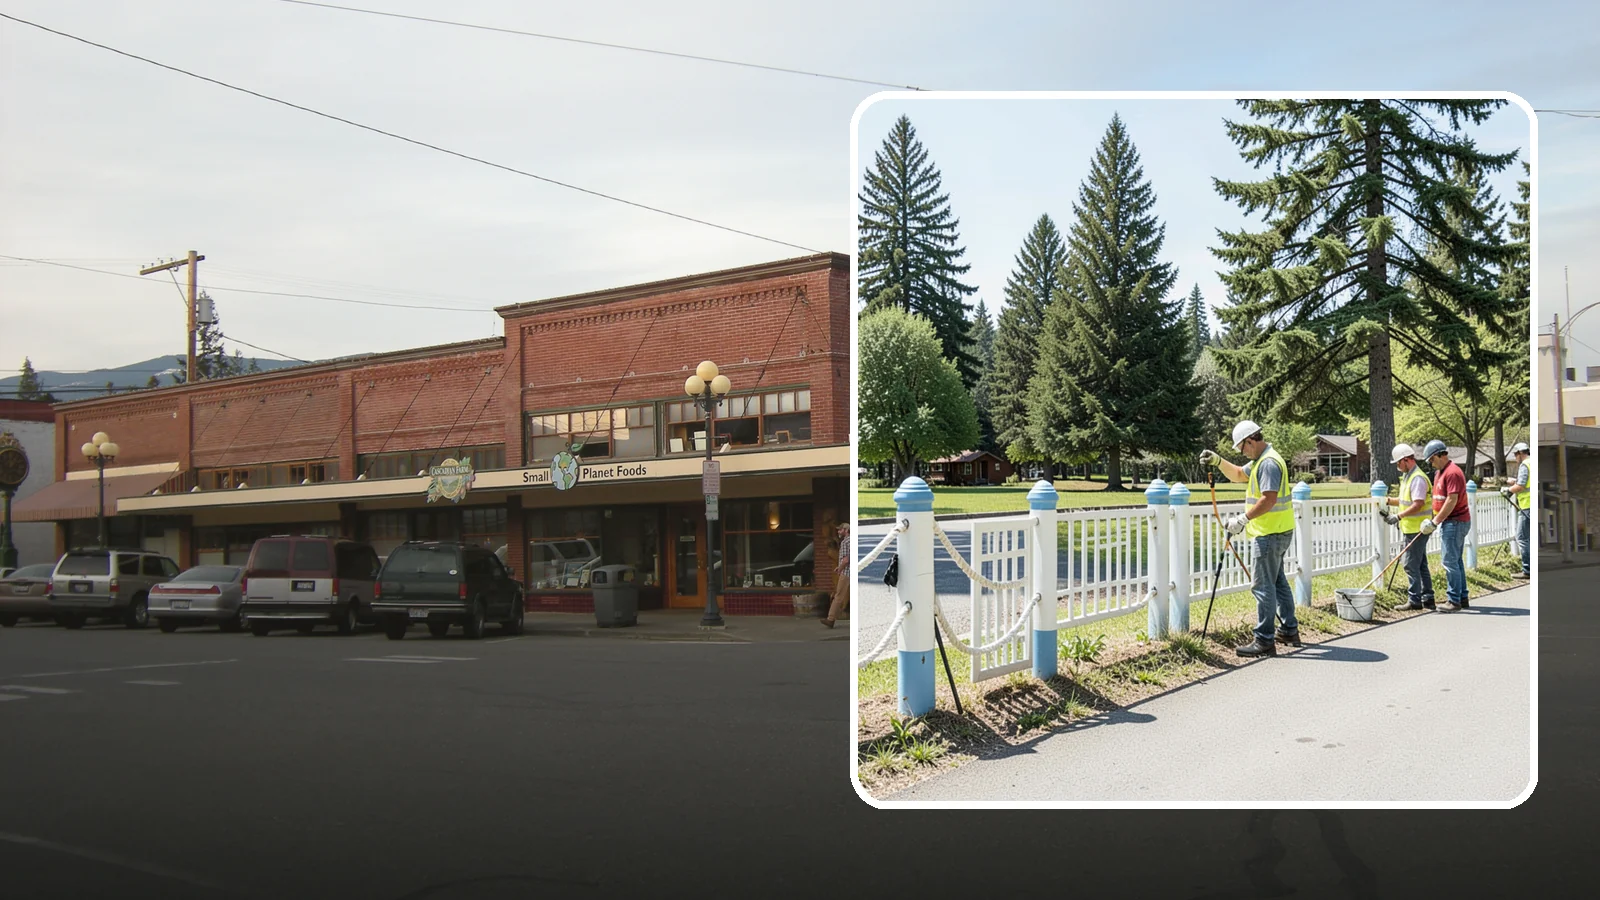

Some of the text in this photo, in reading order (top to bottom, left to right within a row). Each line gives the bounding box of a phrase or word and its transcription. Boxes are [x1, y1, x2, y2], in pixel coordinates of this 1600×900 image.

[523, 464, 647, 483] Small Planet Foods
